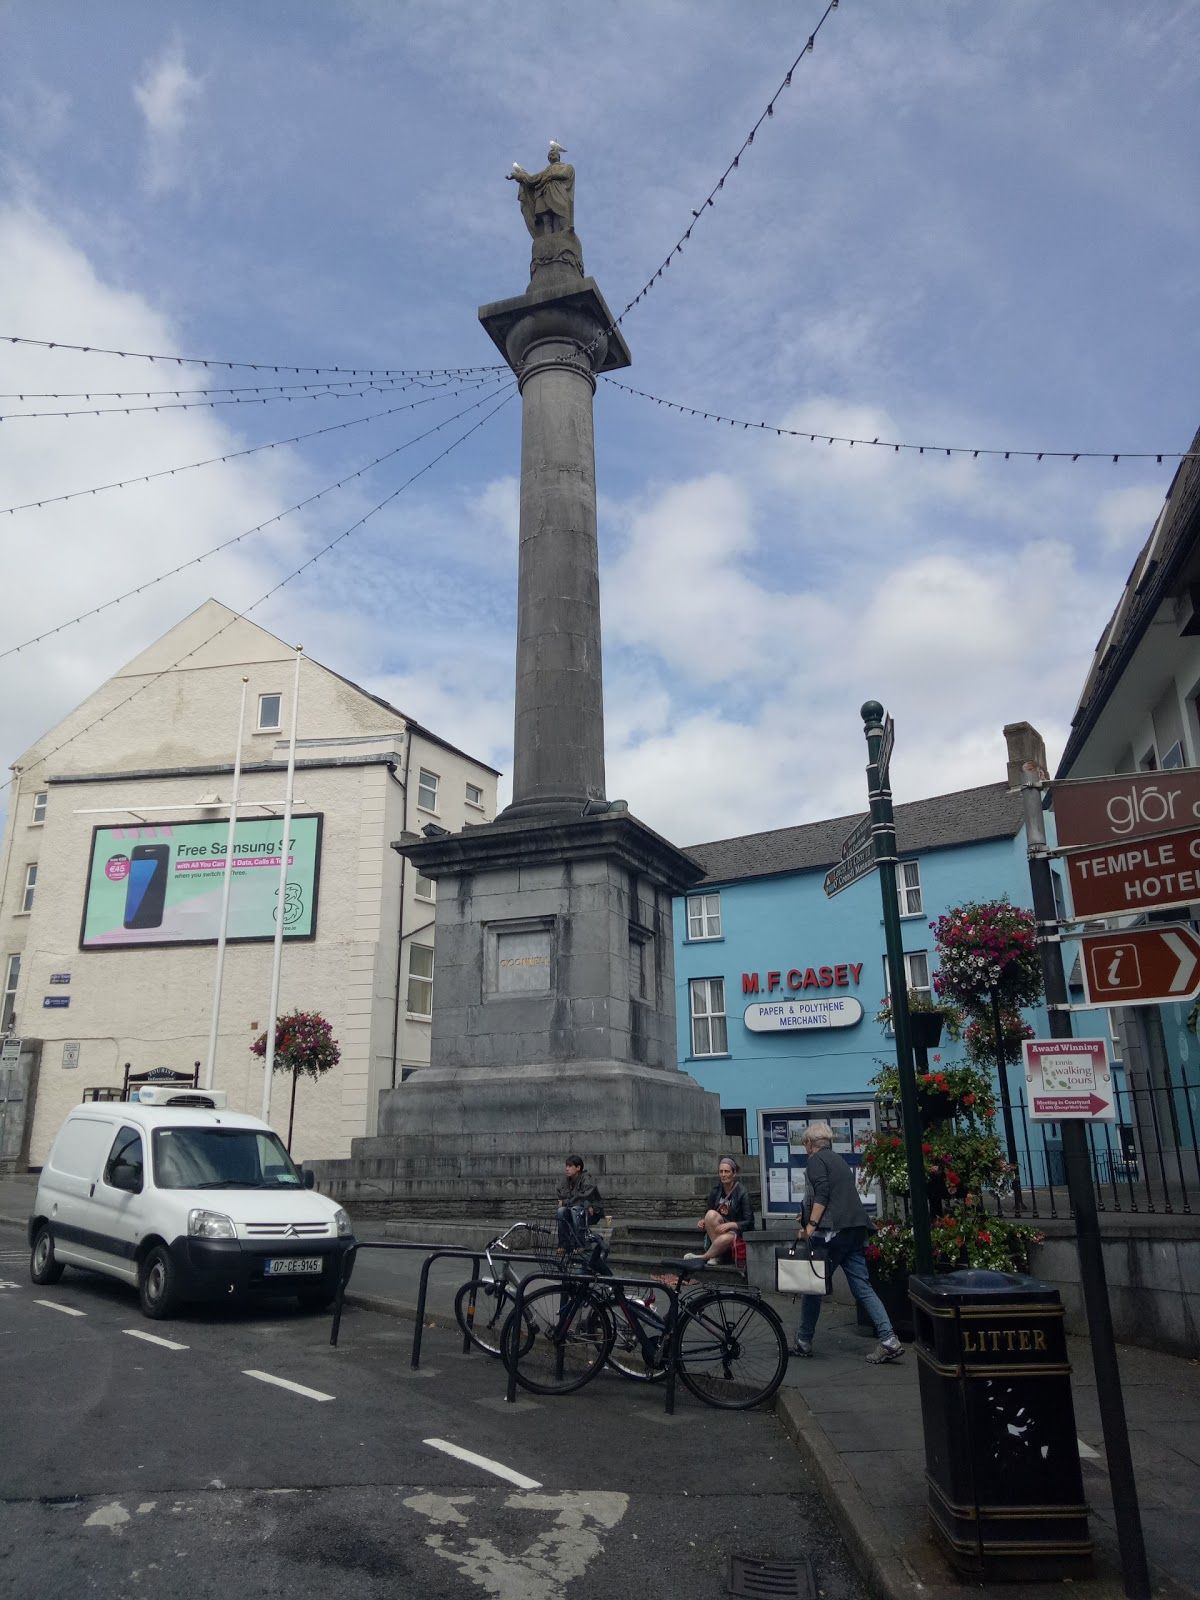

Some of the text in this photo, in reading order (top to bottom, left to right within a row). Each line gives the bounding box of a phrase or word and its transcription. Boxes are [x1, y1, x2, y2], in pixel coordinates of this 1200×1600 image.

[176, 844, 207, 857] Free
[210, 841, 275, 855] Samsung
[1076, 844, 1176, 880] TEMPLE
[786, 962, 864, 991] CASEY
[759, 1001, 845, 1016] PAPER & POLYTHENE
[779, 1014, 828, 1026] MERCHANTS
[1032, 1043, 1099, 1053] Award Winning
[1055, 1065, 1092, 1077] walking
[1067, 1076, 1093, 1085] tours
[273, 1260, 318, 1272] 07-CE-9145
[962, 1329, 1047, 1352] LITTER
